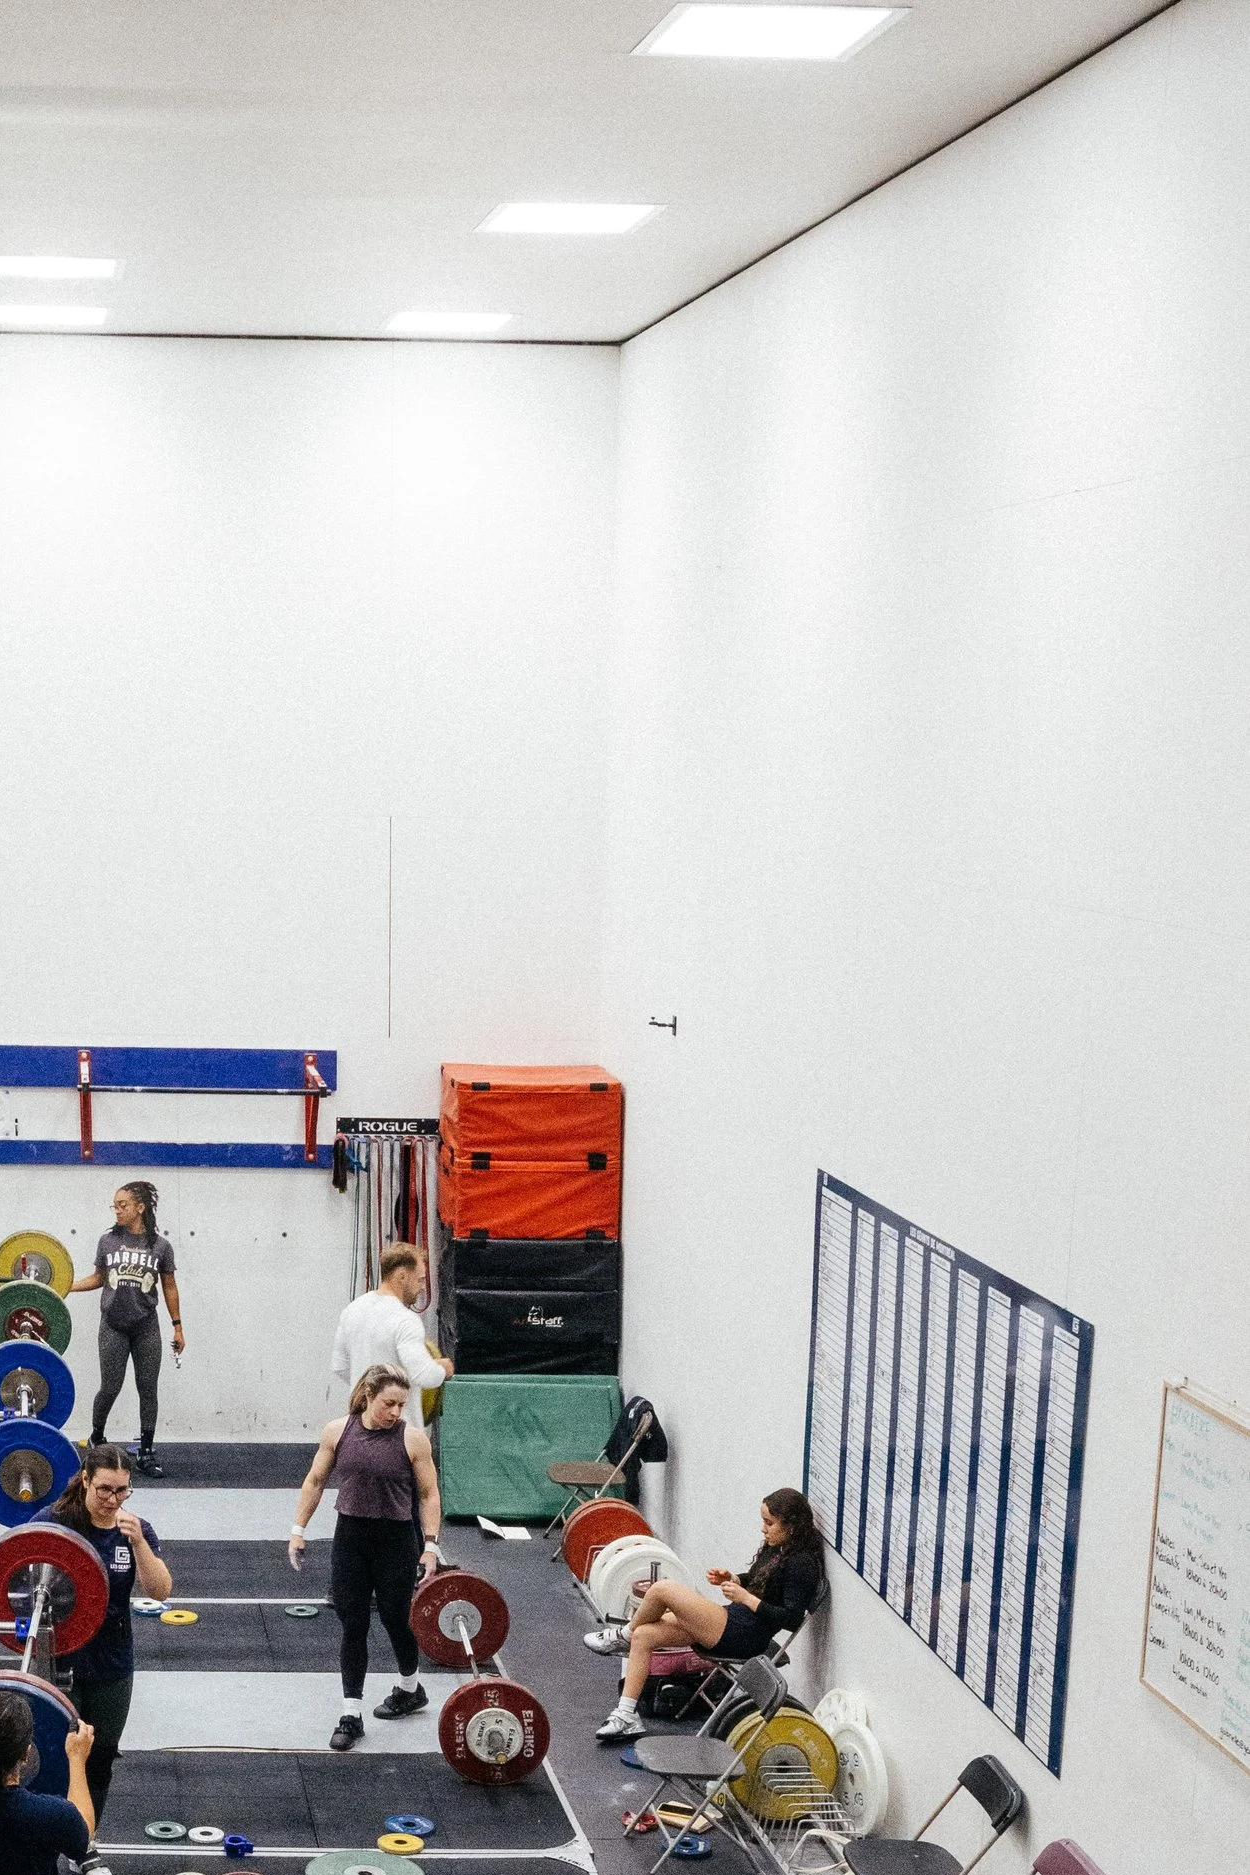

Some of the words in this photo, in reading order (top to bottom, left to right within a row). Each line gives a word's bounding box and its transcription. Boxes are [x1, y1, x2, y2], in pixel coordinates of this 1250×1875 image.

[358, 1121, 418, 1132] ROGUE
[117, 1263, 144, 1276] Club
[521, 1709, 535, 1759] ELEIKO
